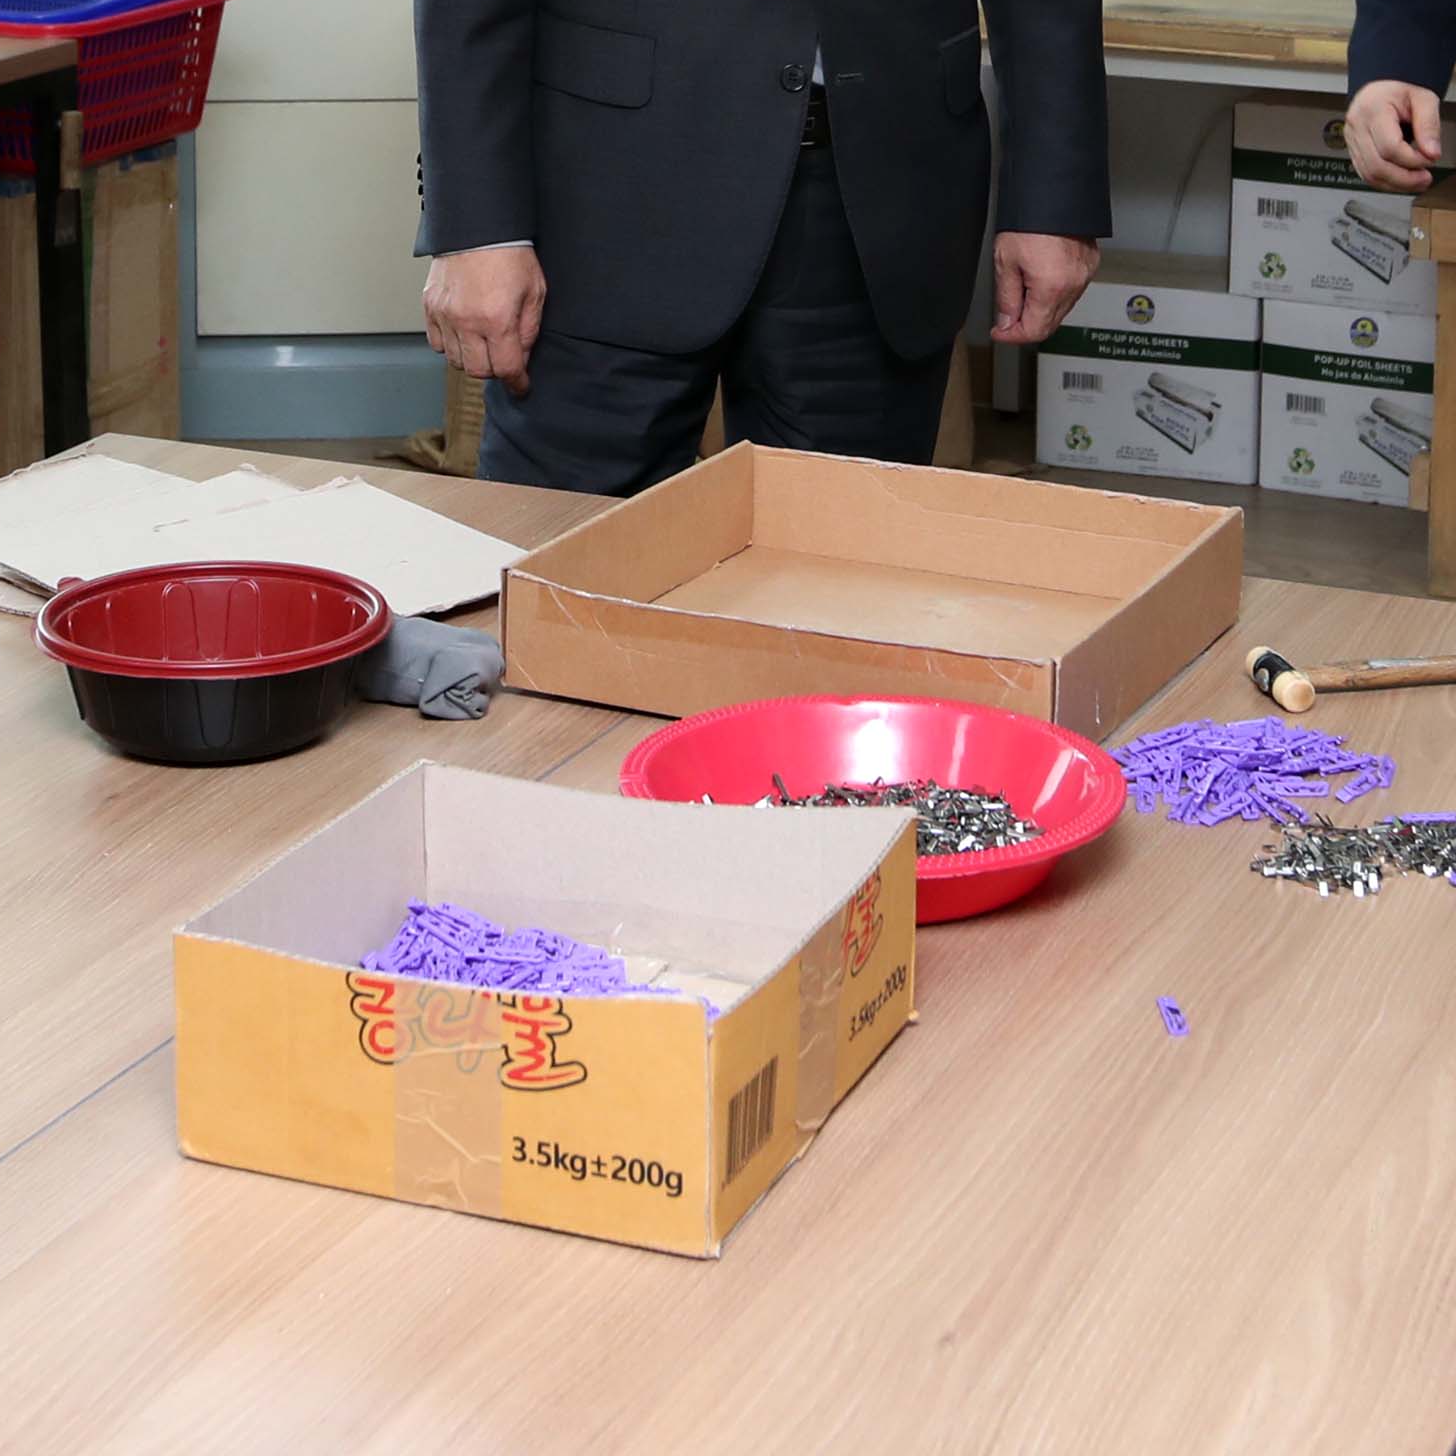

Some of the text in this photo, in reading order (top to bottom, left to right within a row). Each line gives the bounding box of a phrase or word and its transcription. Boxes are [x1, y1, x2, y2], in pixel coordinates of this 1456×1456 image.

[1091, 331, 1190, 350] POP-UP FOIL SHEETS
[1313, 354, 1413, 374] POP-UP FOIL SHEETS
[849, 964, 907, 1042] 3.5kg±200g
[512, 1136, 683, 1197] 3.5kg±200g
